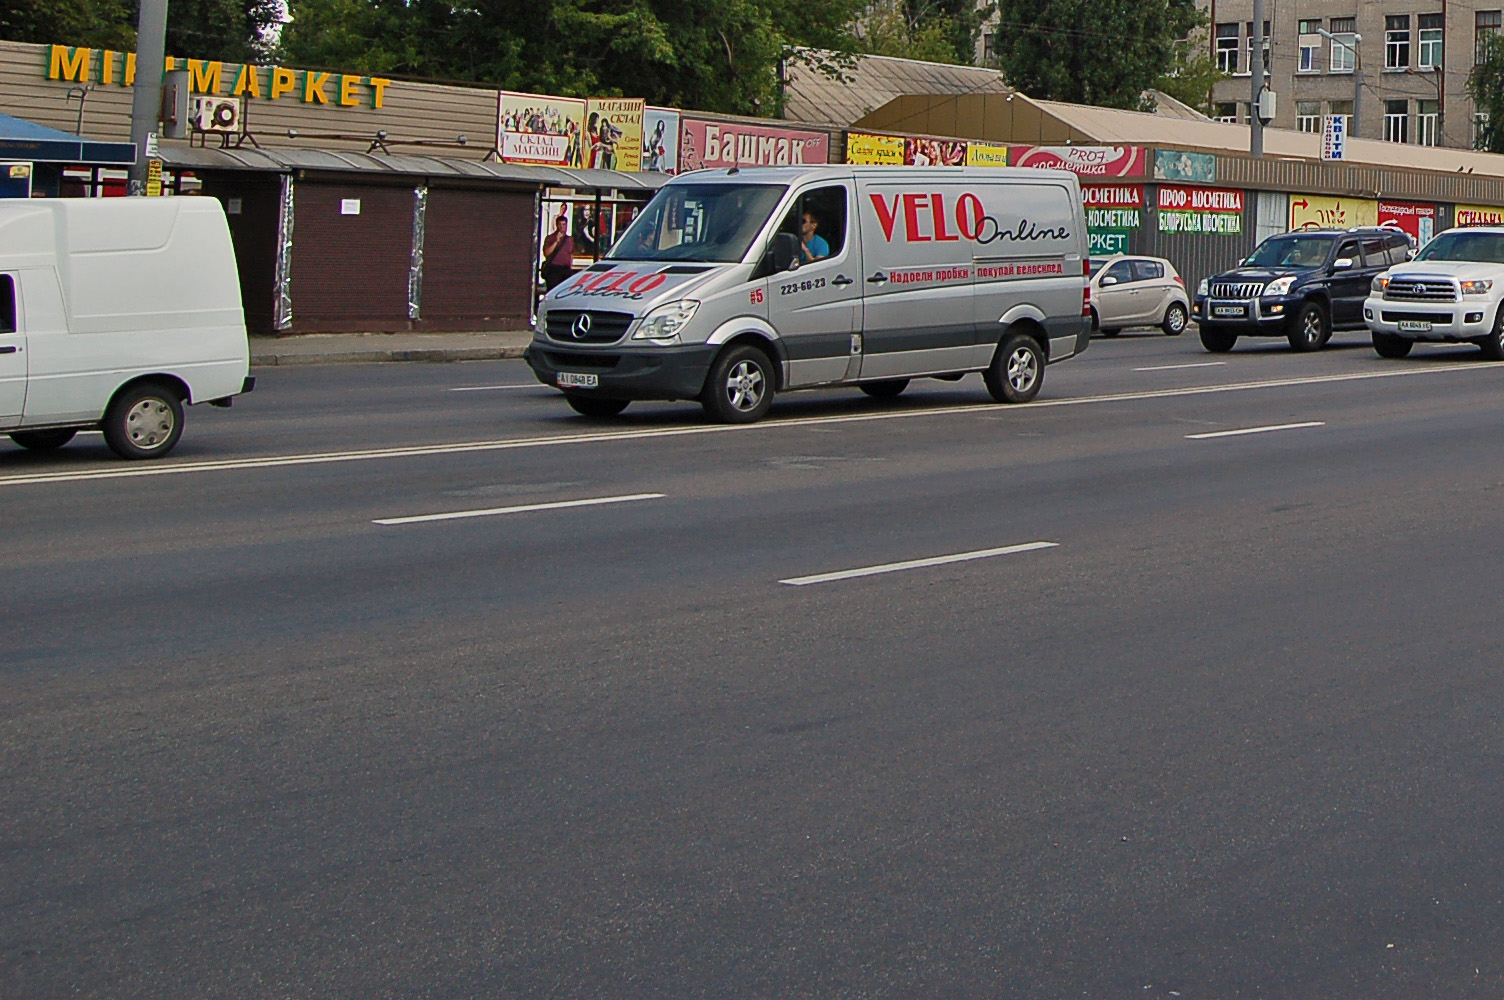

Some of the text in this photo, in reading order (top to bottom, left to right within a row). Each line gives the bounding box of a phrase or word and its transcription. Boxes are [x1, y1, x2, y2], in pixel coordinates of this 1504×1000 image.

[520, 134, 554, 146] СКЛАД
[704, 124, 804, 164] Башмак
[1332, 116, 1342, 158] КВІТИ
[512, 144, 558, 156] МАГАЗИН
[1081, 188, 1140, 204] ОСМЕТИКА
[869, 193, 986, 243] VELO
[976, 216, 1070, 244] Online
[568, 271, 668, 292] VELO
[890, 270, 932, 284] Надоели
[936, 268, 968, 282] пробки
[978, 264, 1014, 278] покупай
[1016, 263, 1063, 276] велосипед
[555, 284, 644, 300] Online
